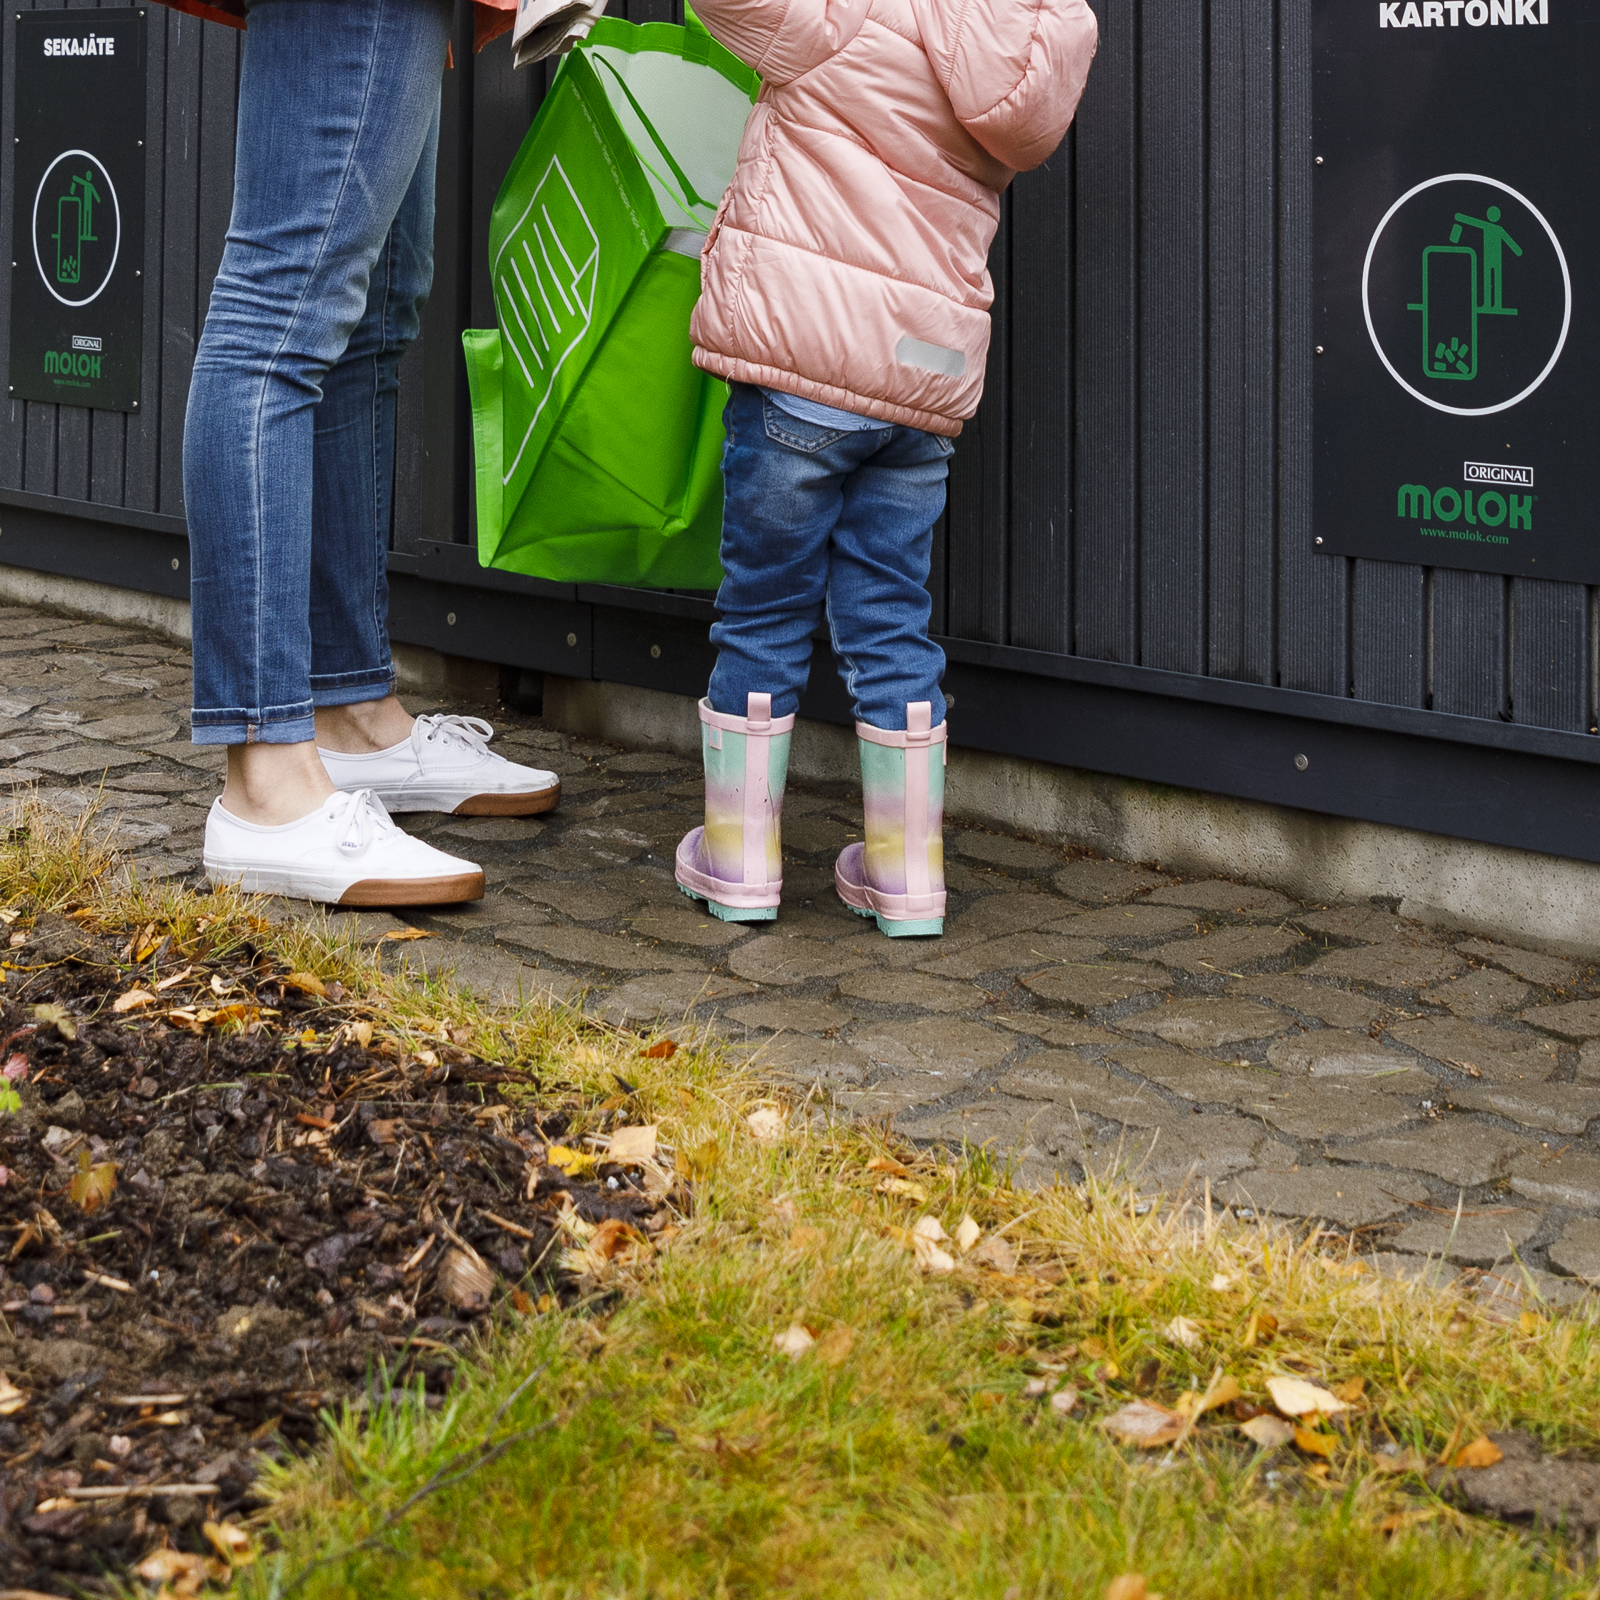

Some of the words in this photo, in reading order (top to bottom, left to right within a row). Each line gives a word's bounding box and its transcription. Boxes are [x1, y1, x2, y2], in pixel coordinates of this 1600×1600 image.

[43, 33, 115, 57] SEKAJÄTE
[74, 338, 99, 348] ORIGINAL
[44, 350, 102, 378] MOLOK
[1468, 465, 1529, 483] ORIGINAL
[1397, 483, 1532, 530] MOLOK
[1420, 527, 1510, 544] www.molok.com
